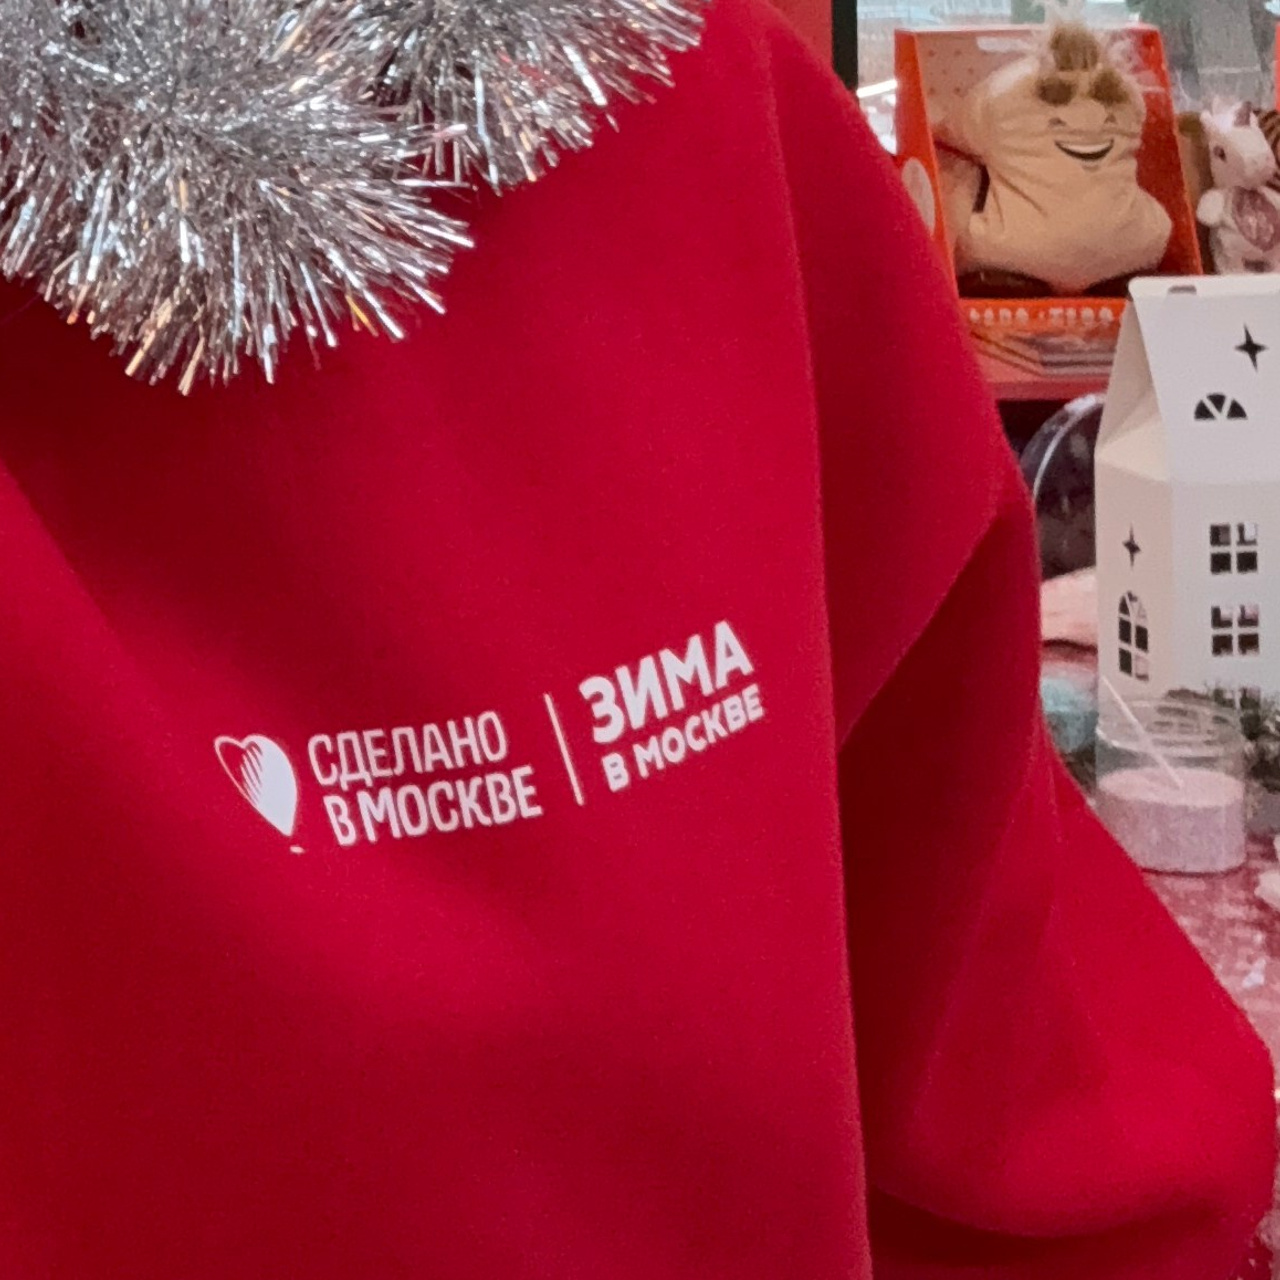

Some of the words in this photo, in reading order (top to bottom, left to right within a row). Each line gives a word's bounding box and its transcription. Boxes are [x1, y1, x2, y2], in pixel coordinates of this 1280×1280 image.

[578, 621, 755, 745] ЗИМА
[308, 711, 508, 791] СДЕЛАНО
[600, 751, 631, 793] В
[632, 683, 765, 779] МОСКВЕ
[322, 793, 358, 847] В
[357, 764, 543, 843] МОСКВЕ
